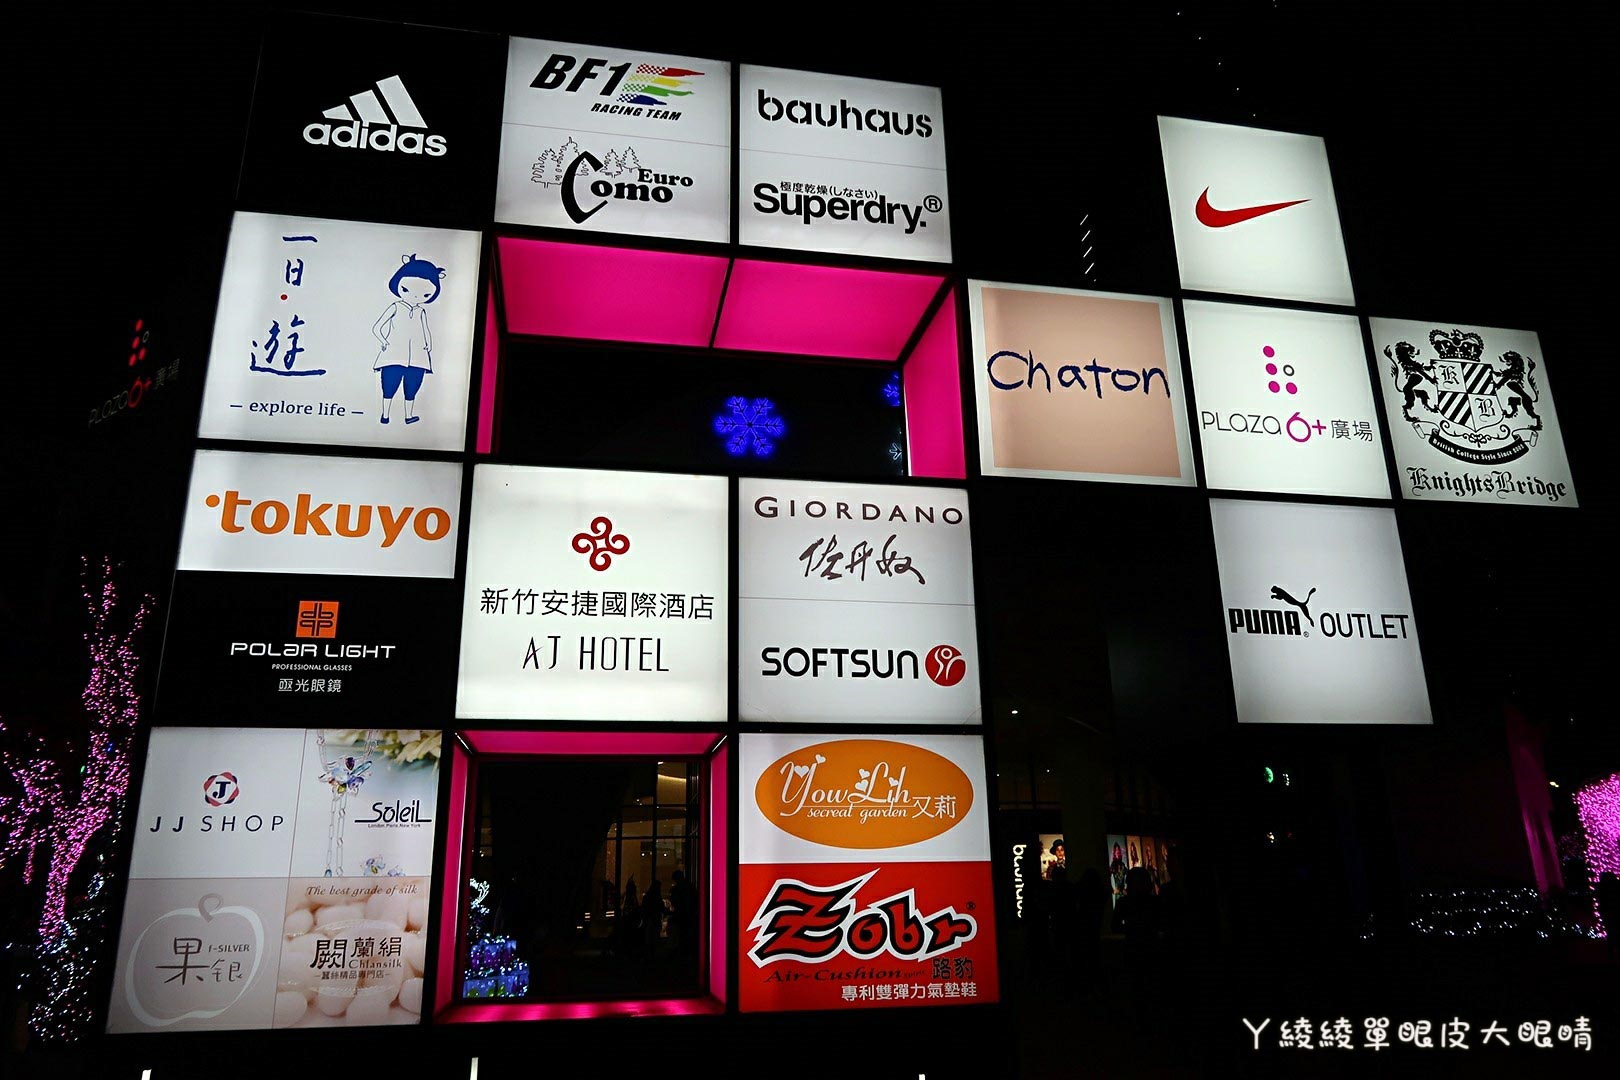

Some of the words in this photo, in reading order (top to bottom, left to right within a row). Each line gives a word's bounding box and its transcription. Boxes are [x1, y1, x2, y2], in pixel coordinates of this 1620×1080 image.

[529, 53, 632, 97] BF1
[591, 103, 643, 118] RACING
[647, 107, 683, 121] TEAM
[757, 89, 933, 138] bauhaus
[303, 120, 448, 157] adidas
[560, 150, 675, 224] Como
[637, 168, 694, 187] Euro
[987, 350, 1170, 399] Chaton
[249, 400, 313, 416] explore
[317, 403, 346, 417] life
[1331, 419, 1373, 442] 廣場
[1406, 466, 1566, 502] KnightsBridge
[205, 490, 451, 547] tokuyo
[754, 496, 963, 525] GIORDANO
[798, 534, 926, 585] 佐丹奴
[480, 587, 715, 620] 新竹安捷國際酒店
[1228, 608, 1301, 636] PUMA
[1319, 612, 1409, 639] OUTLET
[324, 645, 396, 659] LIGHT
[522, 636, 562, 669] AJ
[579, 636, 670, 672] HOTEL
[761, 647, 919, 680] SOFTSUN
[271, 663, 322, 671] PROFESSIONAL
[323, 664, 353, 672] GLASSES
[859, 802, 908, 824] garden
[911, 795, 957, 819] 又莉
[201, 815, 284, 832] SHOP
[306, 886, 328, 896] The
[330, 886, 351, 896] best
[351, 887, 382, 899] grade
[385, 886, 397, 897] of
[398, 886, 417, 896] silk
[309, 936, 402, 970] 闕蘭絹
[931, 957, 974, 980] 路豹
[841, 981, 978, 1001] 專利雙彈力氣墊鞋
